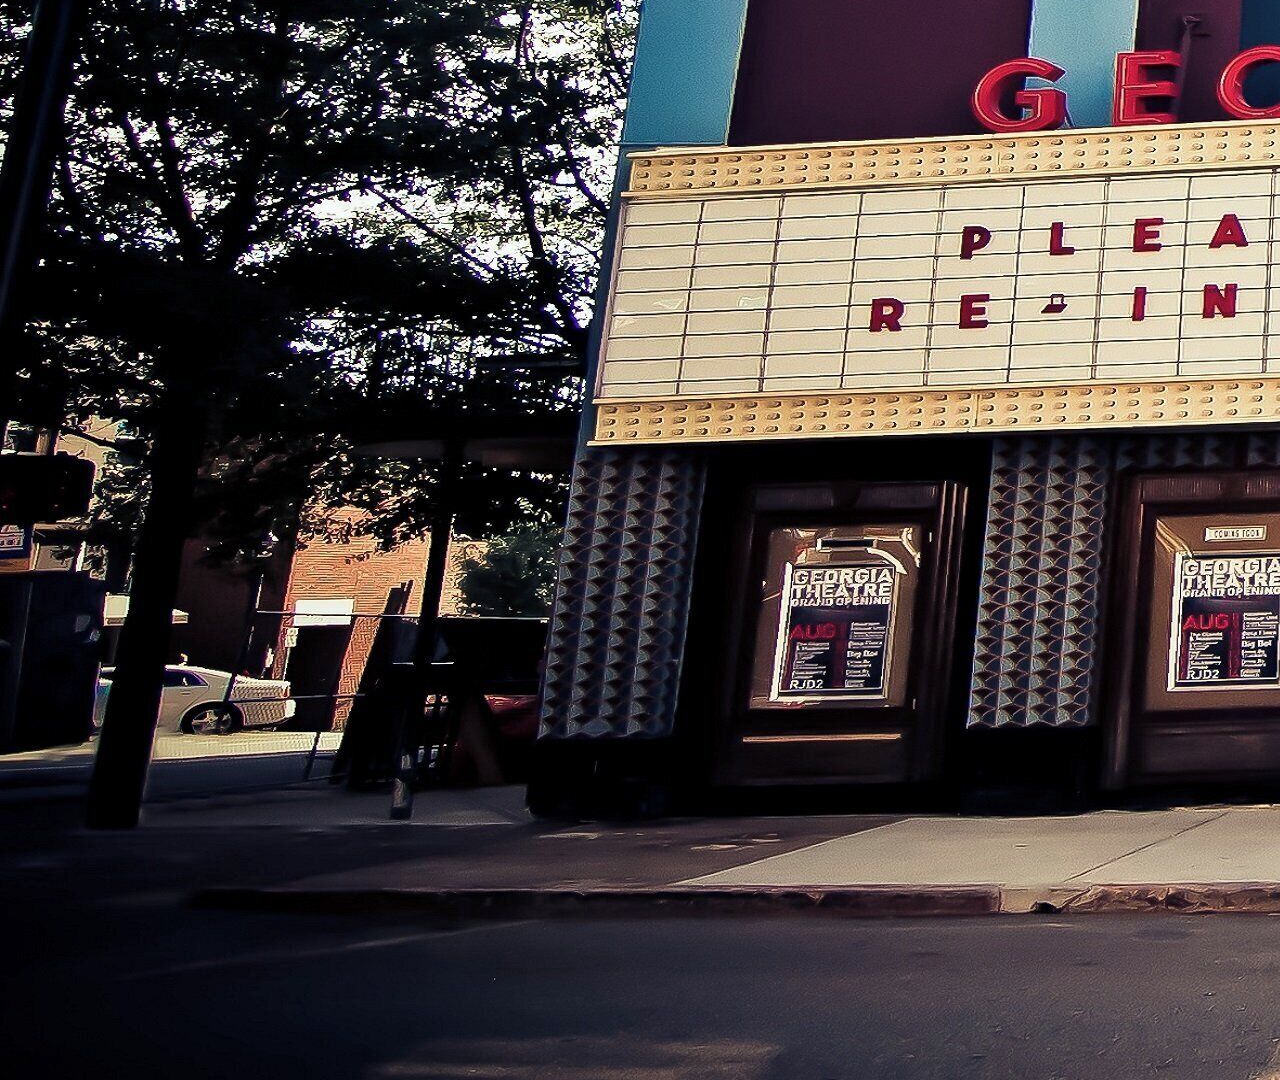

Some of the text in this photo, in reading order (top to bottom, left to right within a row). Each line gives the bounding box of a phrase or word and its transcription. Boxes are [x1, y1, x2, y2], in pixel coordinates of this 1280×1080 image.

[793, 568, 894, 585] GEORGIA
[791, 583, 893, 599] THEATRE
[1182, 587, 1226, 597] GRAND
[791, 596, 891, 607] GRAND OPENING
[1182, 612, 1229, 631] AUG
[790, 622, 837, 640] AUG
[1187, 669, 1220, 680] RJD2
[789, 679, 824, 690] RJD2
